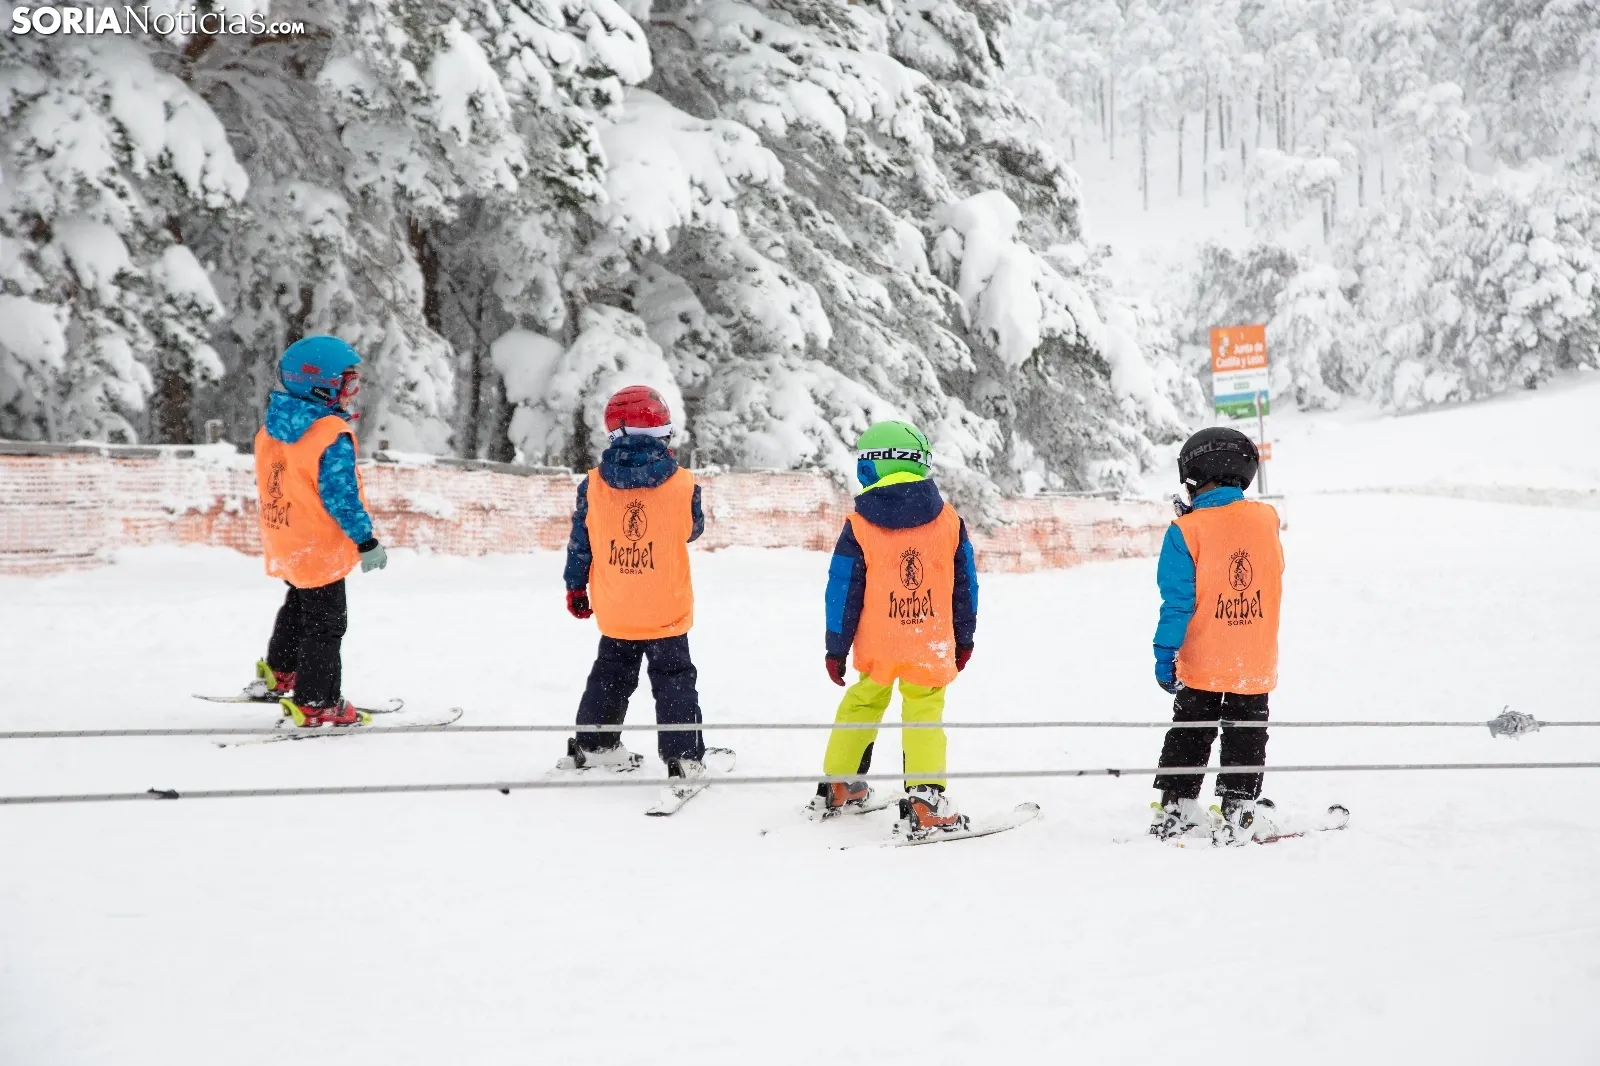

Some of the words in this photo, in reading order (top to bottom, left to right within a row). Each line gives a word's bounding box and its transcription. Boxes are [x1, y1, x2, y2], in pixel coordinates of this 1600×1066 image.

[1233, 343, 1253, 354] Junta
[1254, 342, 1264, 353] de
[608, 538, 655, 569] herbel
[619, 567, 643, 575] SORIA
[888, 588, 935, 619] herbel
[1214, 589, 1264, 619] herbel
[1227, 619, 1253, 627] SORIA
